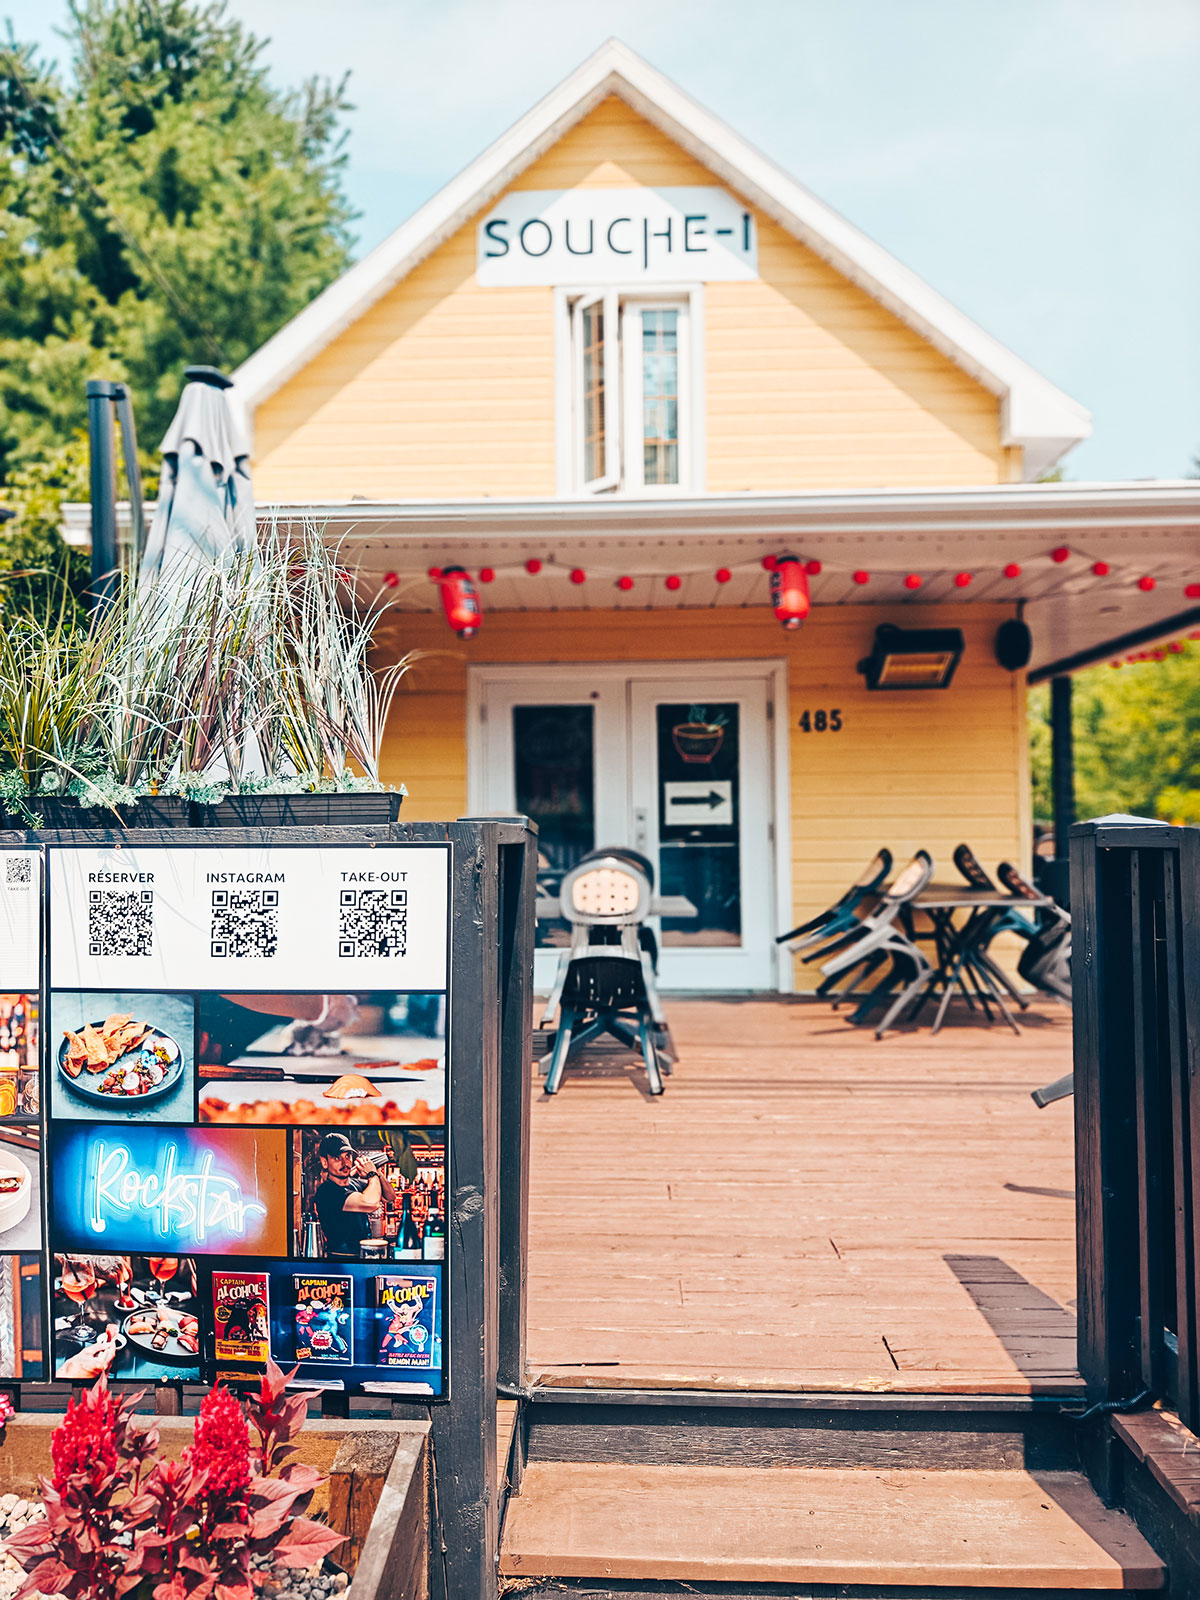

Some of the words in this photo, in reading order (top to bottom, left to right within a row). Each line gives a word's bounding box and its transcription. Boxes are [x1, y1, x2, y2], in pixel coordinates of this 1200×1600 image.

[799, 708, 843, 733] 485
[88, 870, 155, 883] RÉSERVER
[206, 872, 286, 883] INSTAGRAM
[341, 871, 408, 882] TAKE-OUT
[217, 1283, 262, 1301] ALCOHOL
[298, 1284, 344, 1302] ALCOHOL
[382, 1285, 429, 1304] ALCOHOL
